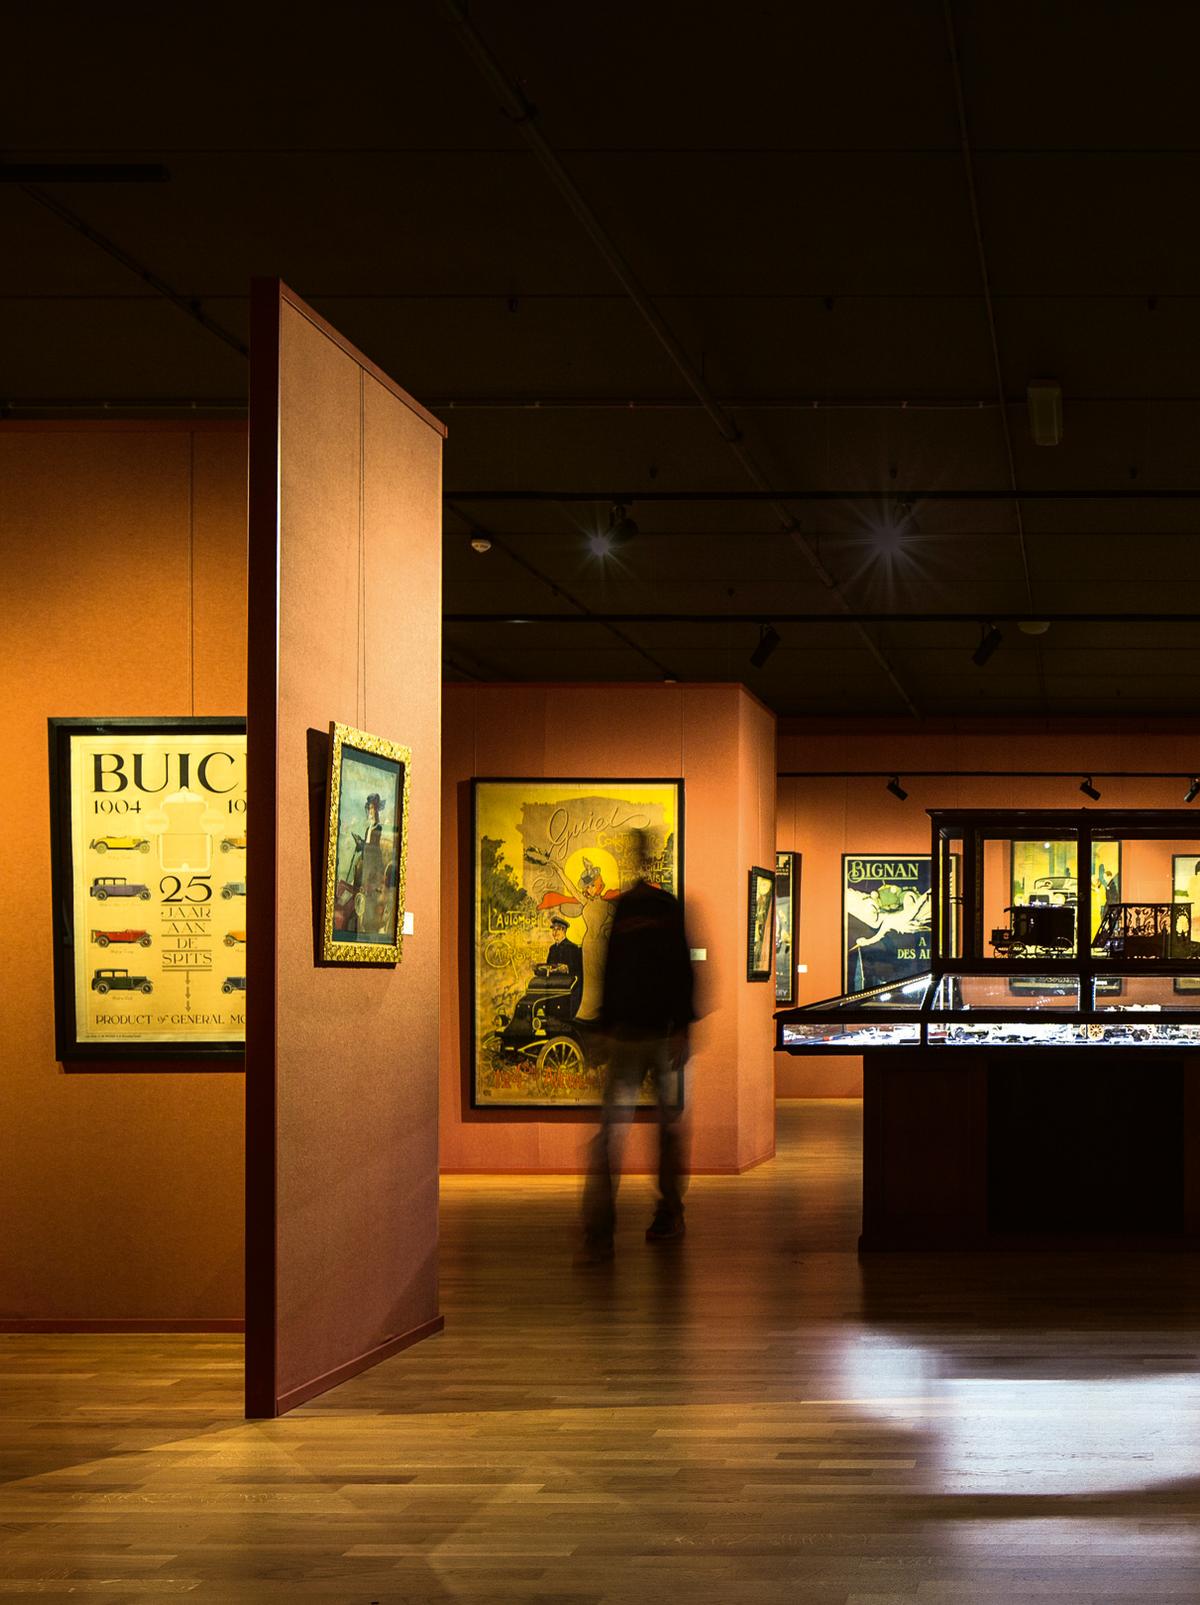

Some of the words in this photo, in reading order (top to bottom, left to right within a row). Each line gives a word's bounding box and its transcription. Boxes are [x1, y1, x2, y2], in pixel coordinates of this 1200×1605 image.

[91, 752, 247, 793] BUIC
[94, 799, 142, 815] 1904
[848, 861, 919, 883] BIGNAN
[160, 875, 212, 902] 25
[176, 938, 198, 949] DE
[161, 953, 213, 964] SPITS
[896, 948, 916, 960] DES
[95, 1014, 153, 1025] PRODUCT
[157, 1014, 169, 1025] of
[170, 1014, 225, 1025] GENERAL
